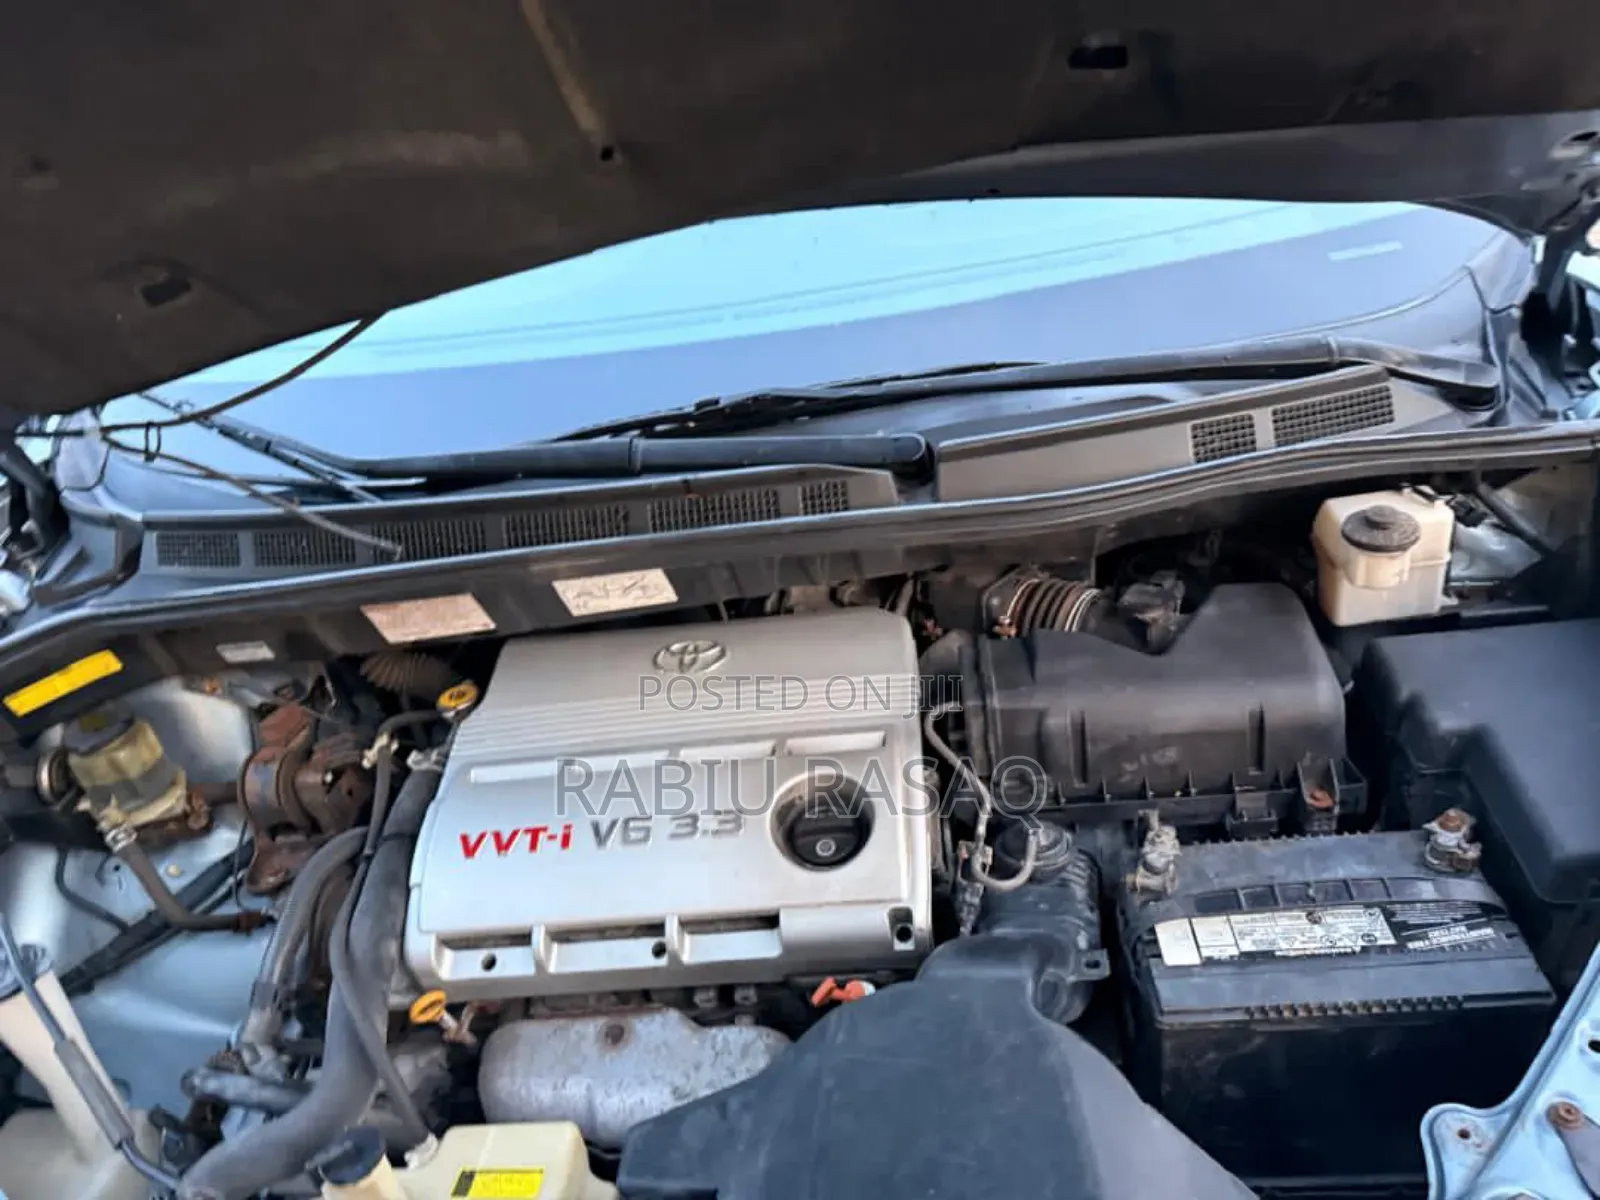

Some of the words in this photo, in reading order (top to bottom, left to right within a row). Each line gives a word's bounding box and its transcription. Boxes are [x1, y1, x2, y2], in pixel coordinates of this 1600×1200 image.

[460, 823, 574, 859] VVT-i
[591, 814, 653, 848] V6
[669, 808, 745, 840] 3.3
